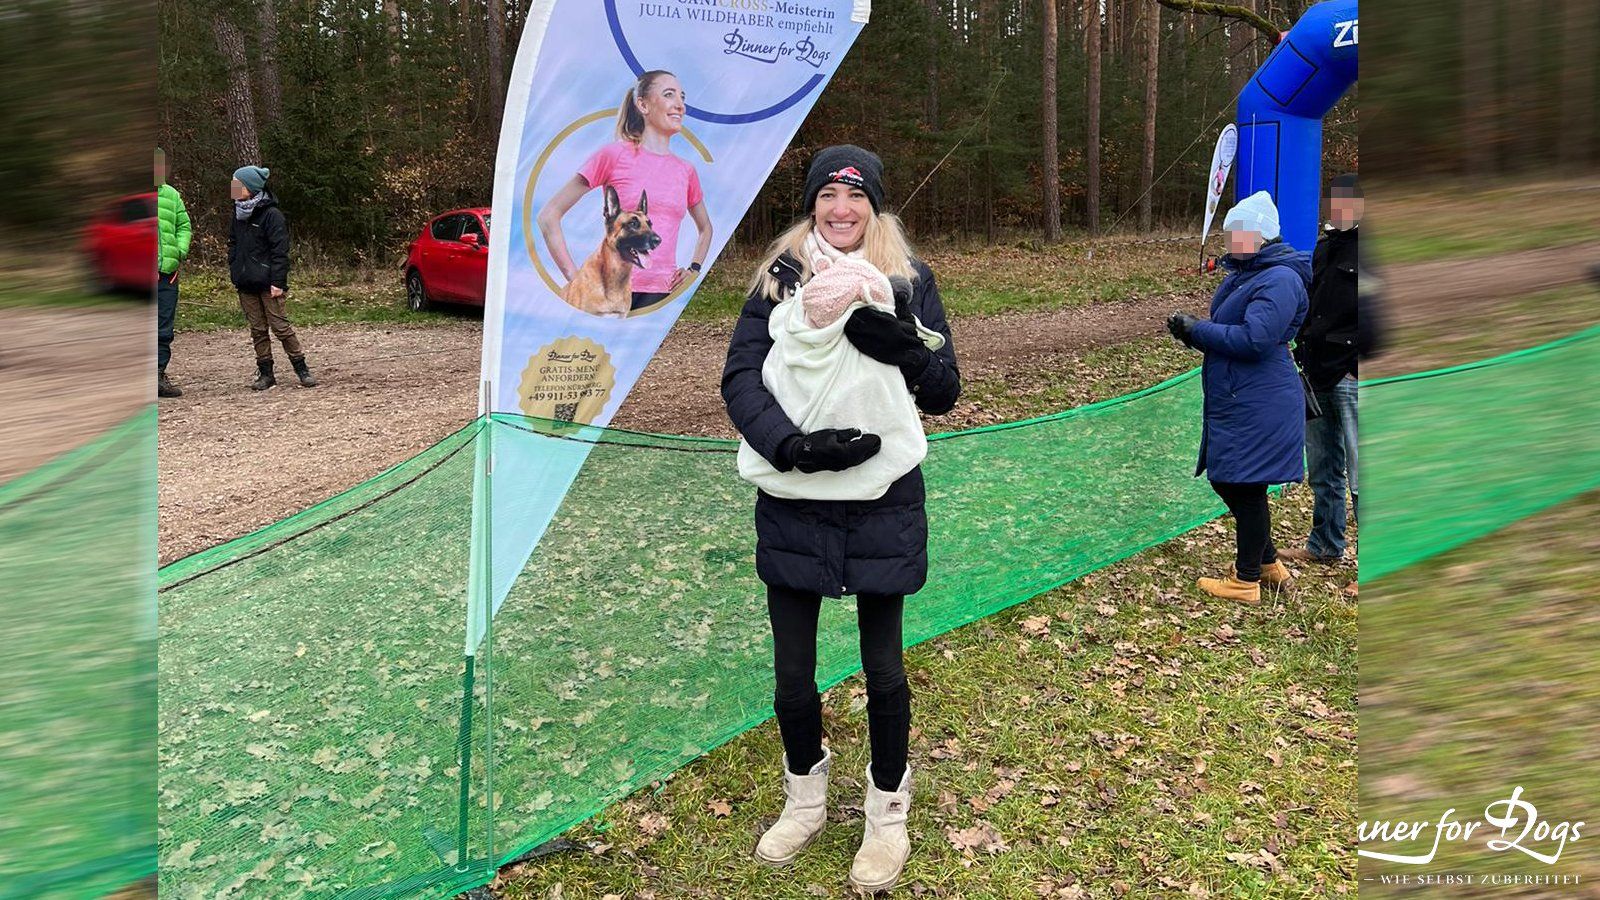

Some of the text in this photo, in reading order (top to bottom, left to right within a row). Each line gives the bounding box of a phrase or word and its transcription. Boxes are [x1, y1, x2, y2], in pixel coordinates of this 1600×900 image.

[638, 5, 834, 34] JULIA WILDHABER empfiehlt
[723, 28, 831, 68] Dinner for Dogs
[528, 392, 546, 401] +49
[547, 391, 578, 400] 911-53
[595, 388, 606, 398] 77
[534, 384, 566, 392] TELEFON
